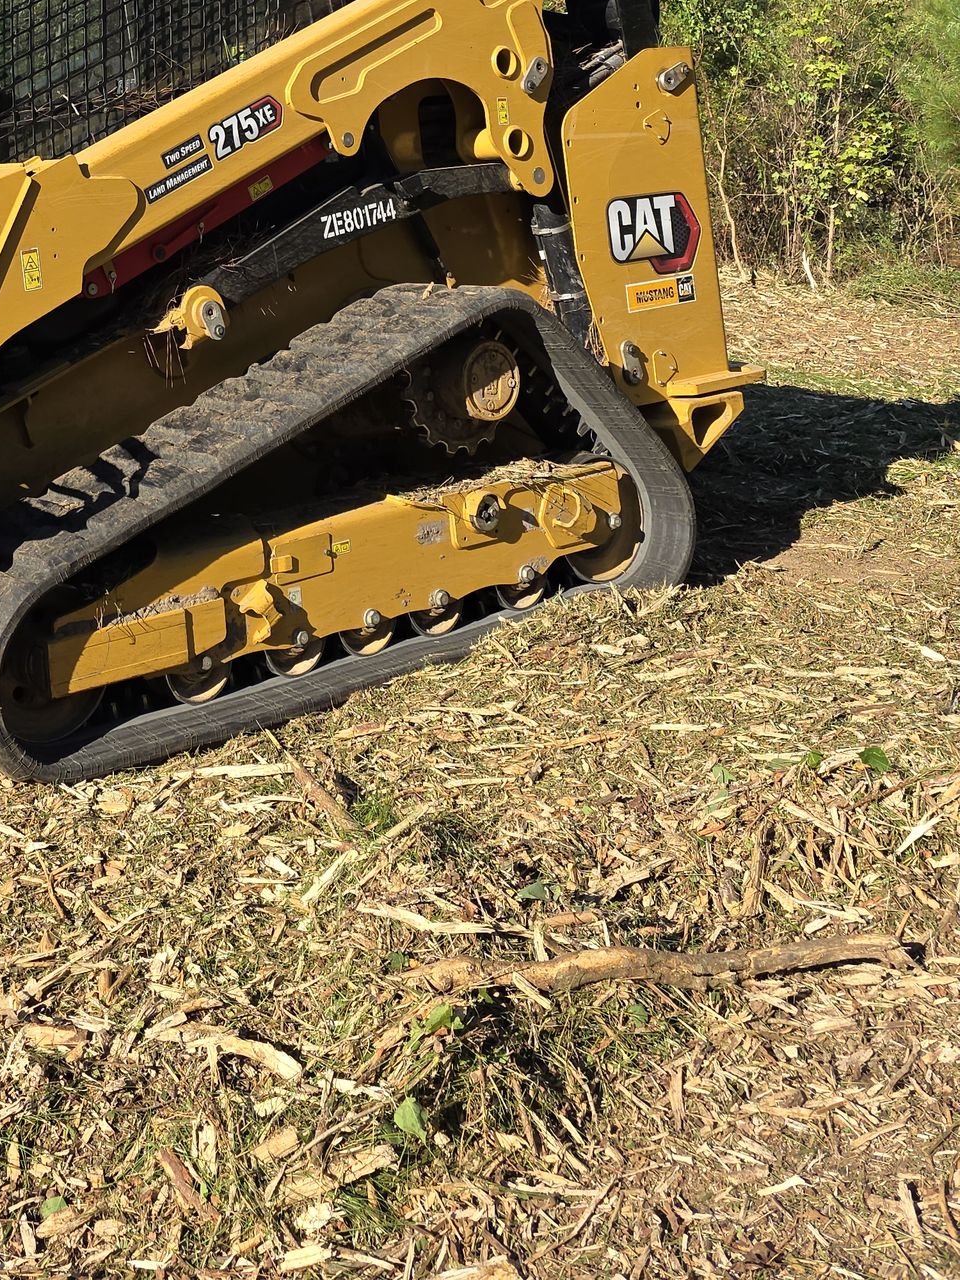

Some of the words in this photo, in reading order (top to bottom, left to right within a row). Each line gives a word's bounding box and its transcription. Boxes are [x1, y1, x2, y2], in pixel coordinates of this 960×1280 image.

[320, 198, 396, 239] ZE801744
[608, 194, 676, 261] CAT
[635, 286, 674, 304] MUSTANG
[678, 282, 693, 297] CAT
